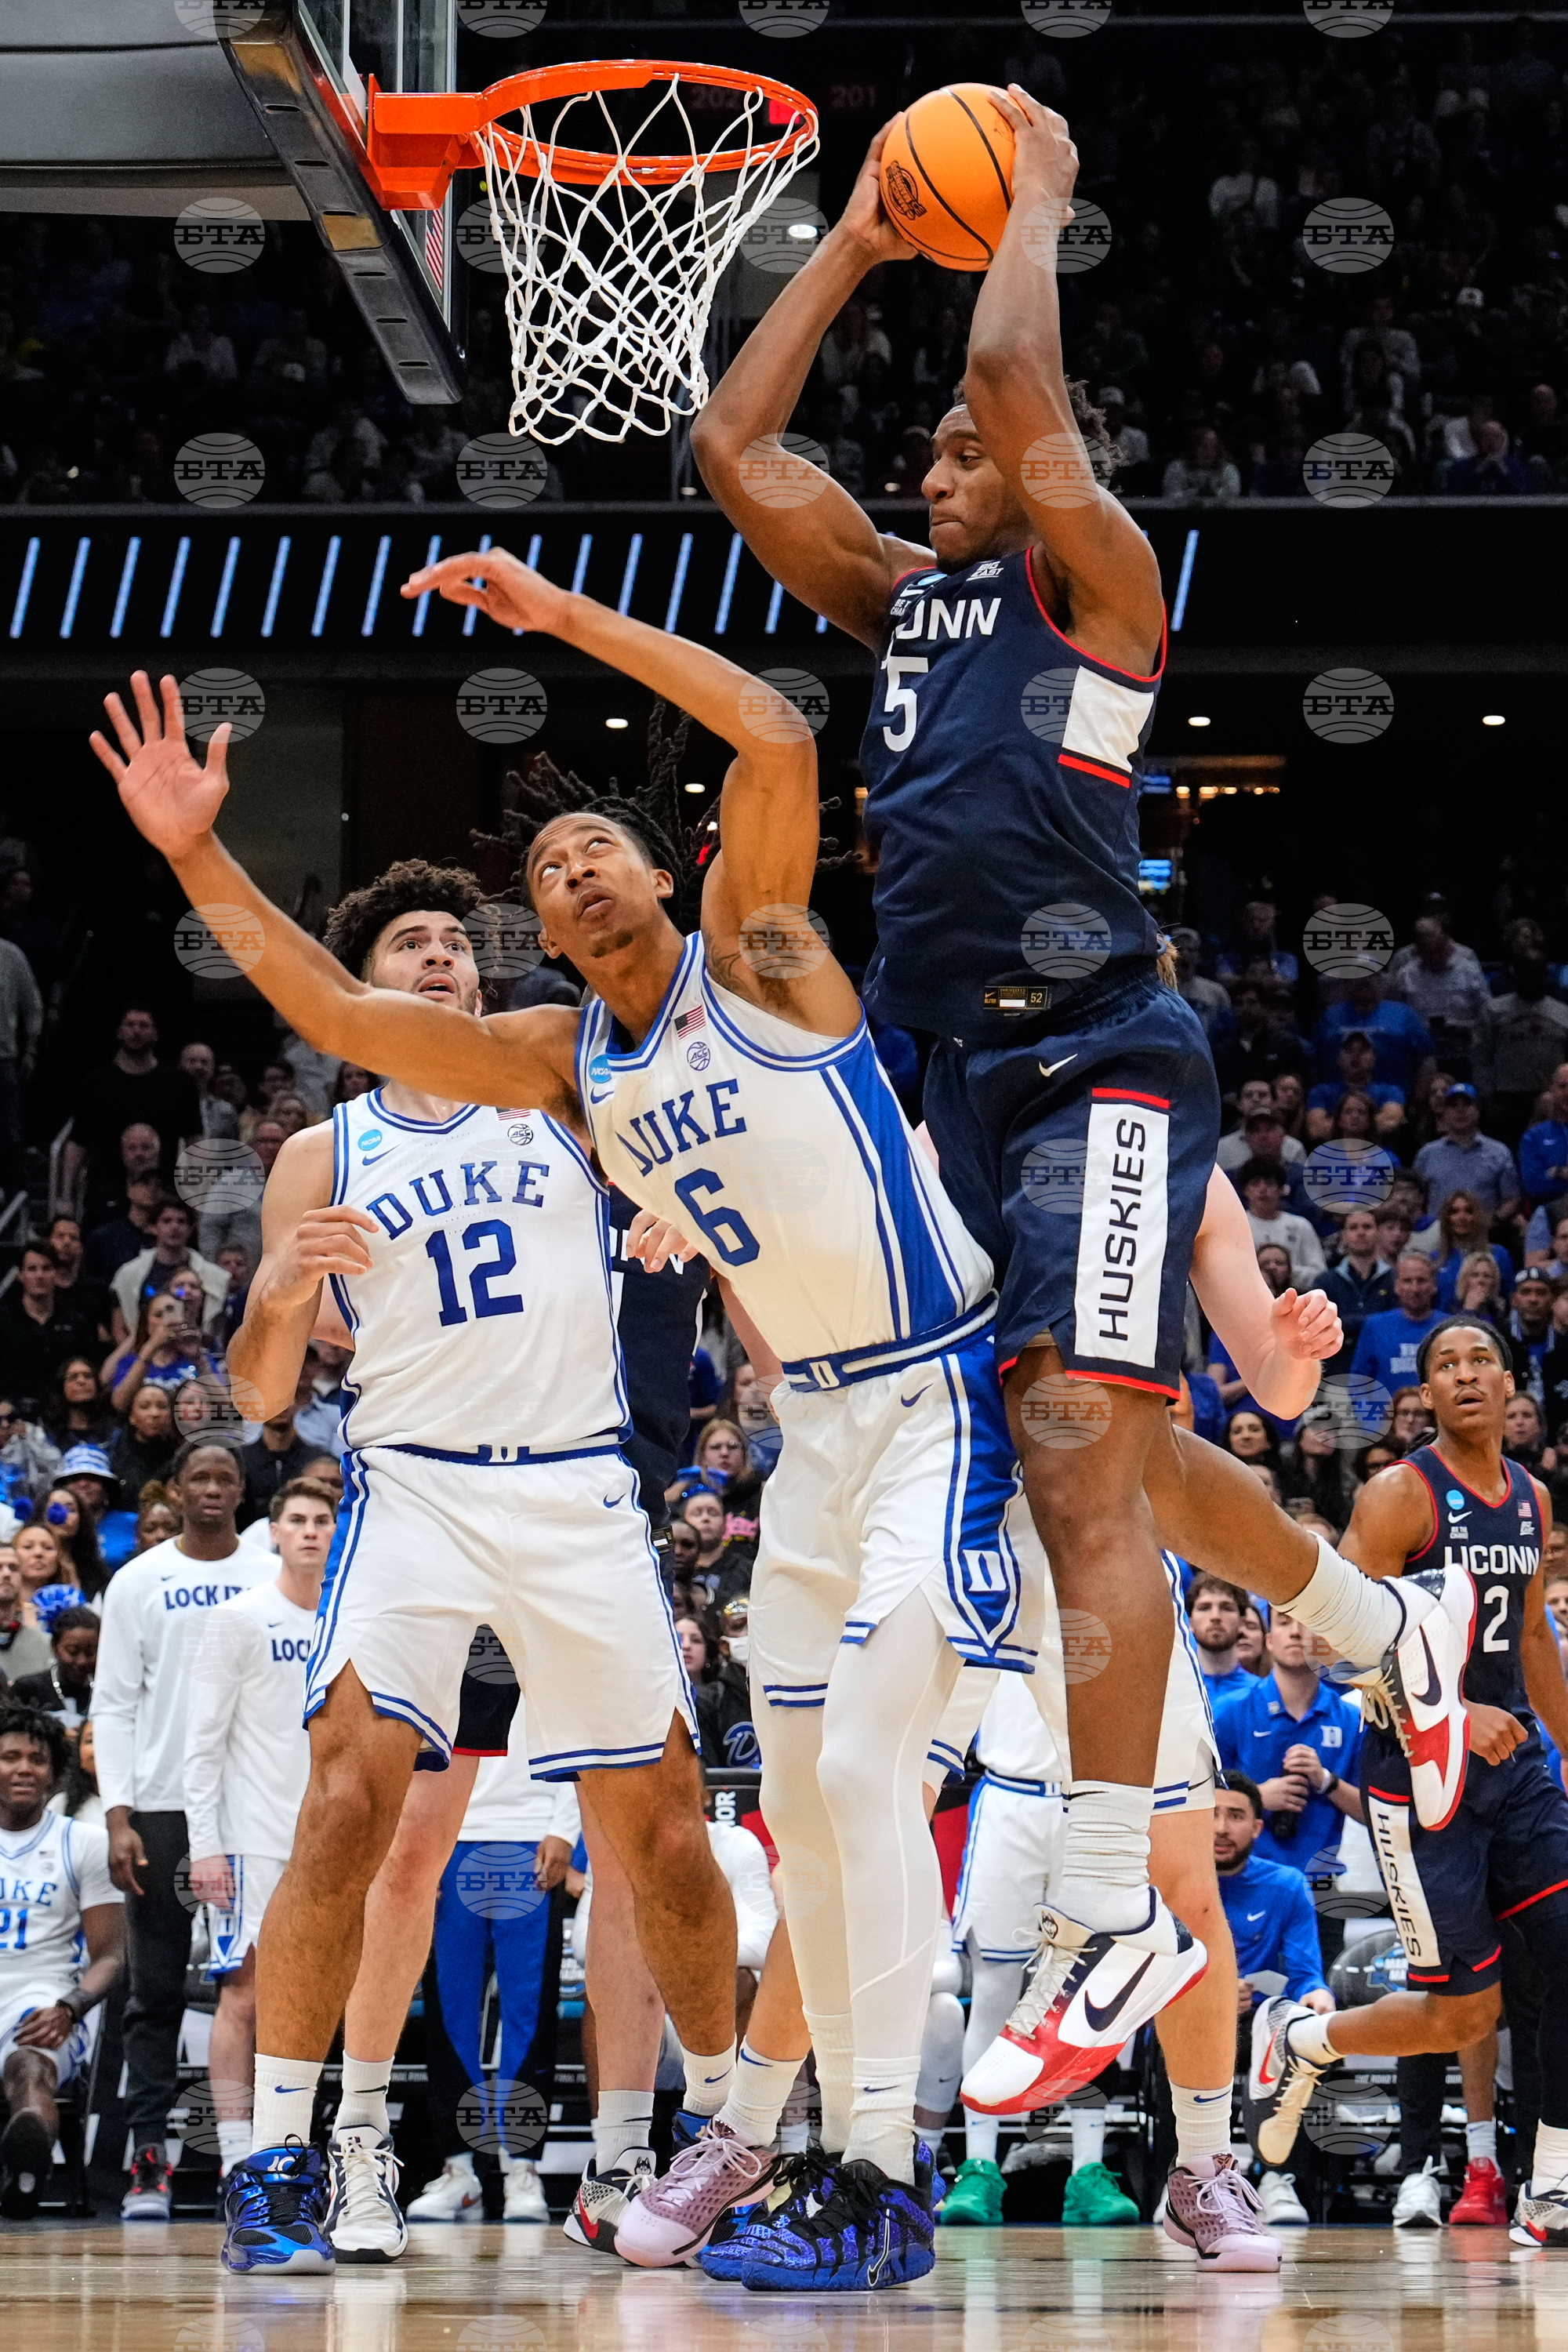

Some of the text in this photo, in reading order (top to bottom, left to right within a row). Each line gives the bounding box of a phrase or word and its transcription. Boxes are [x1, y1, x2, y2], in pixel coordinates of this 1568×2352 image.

[971, 568, 1004, 577] EAST
[977, 561, 1000, 571] BIG
[881, 655, 929, 753] 5
[1030, 993, 1043, 1004] 52
[691, 1048, 708, 1062] ACC
[365, 1160, 550, 1241] DUKE
[674, 1167, 760, 1267] 6
[1098, 1118, 1146, 1341] HUSKIES
[425, 1218, 524, 1327] 12
[1444, 1544, 1540, 1576] UCONN
[164, 1585, 218, 1610] LOCK
[1483, 1585, 1510, 1653] 2
[1377, 1813, 1421, 1958] HUSKIES
